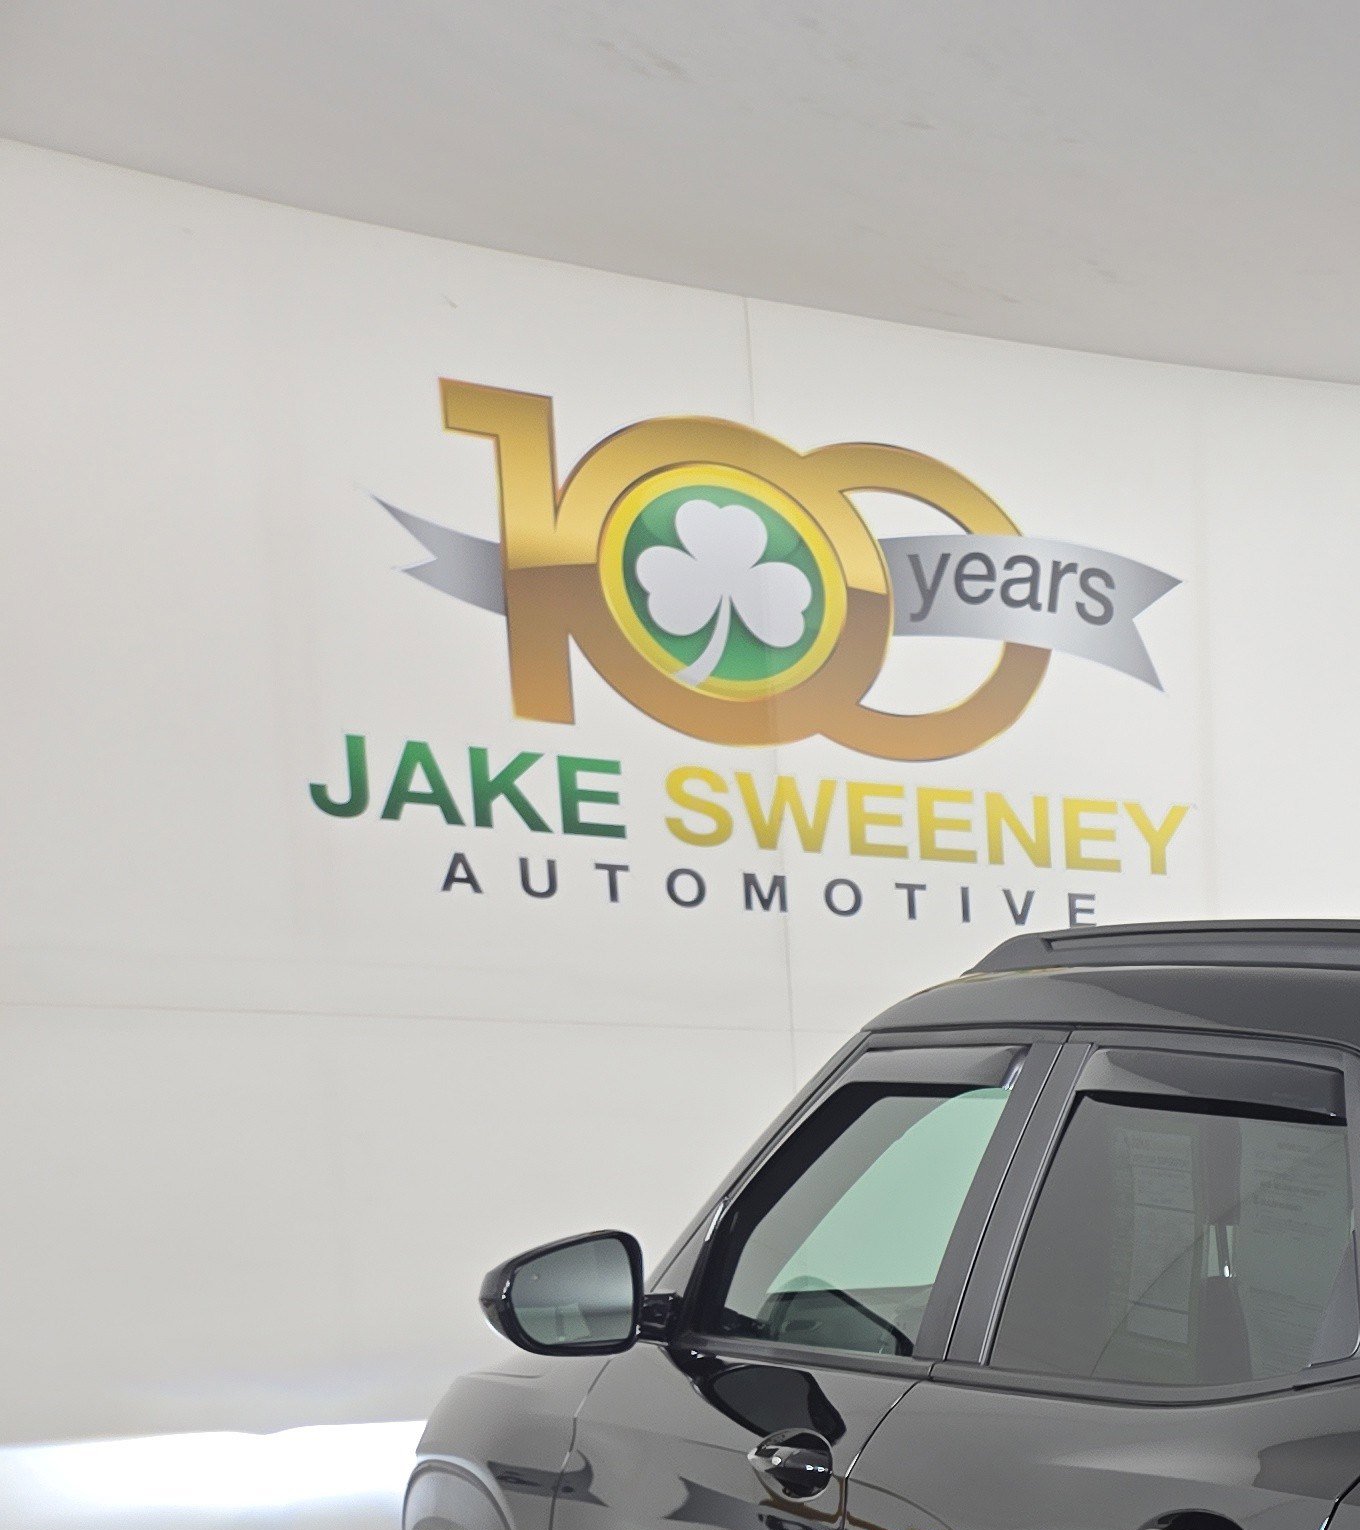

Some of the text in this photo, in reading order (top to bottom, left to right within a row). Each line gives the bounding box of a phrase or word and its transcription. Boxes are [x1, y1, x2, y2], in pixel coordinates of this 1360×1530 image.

[907, 551, 1116, 626] years
[309, 734, 1189, 876] JAKE SWEENEY
[441, 853, 1098, 927] AUTOMOTIVE
